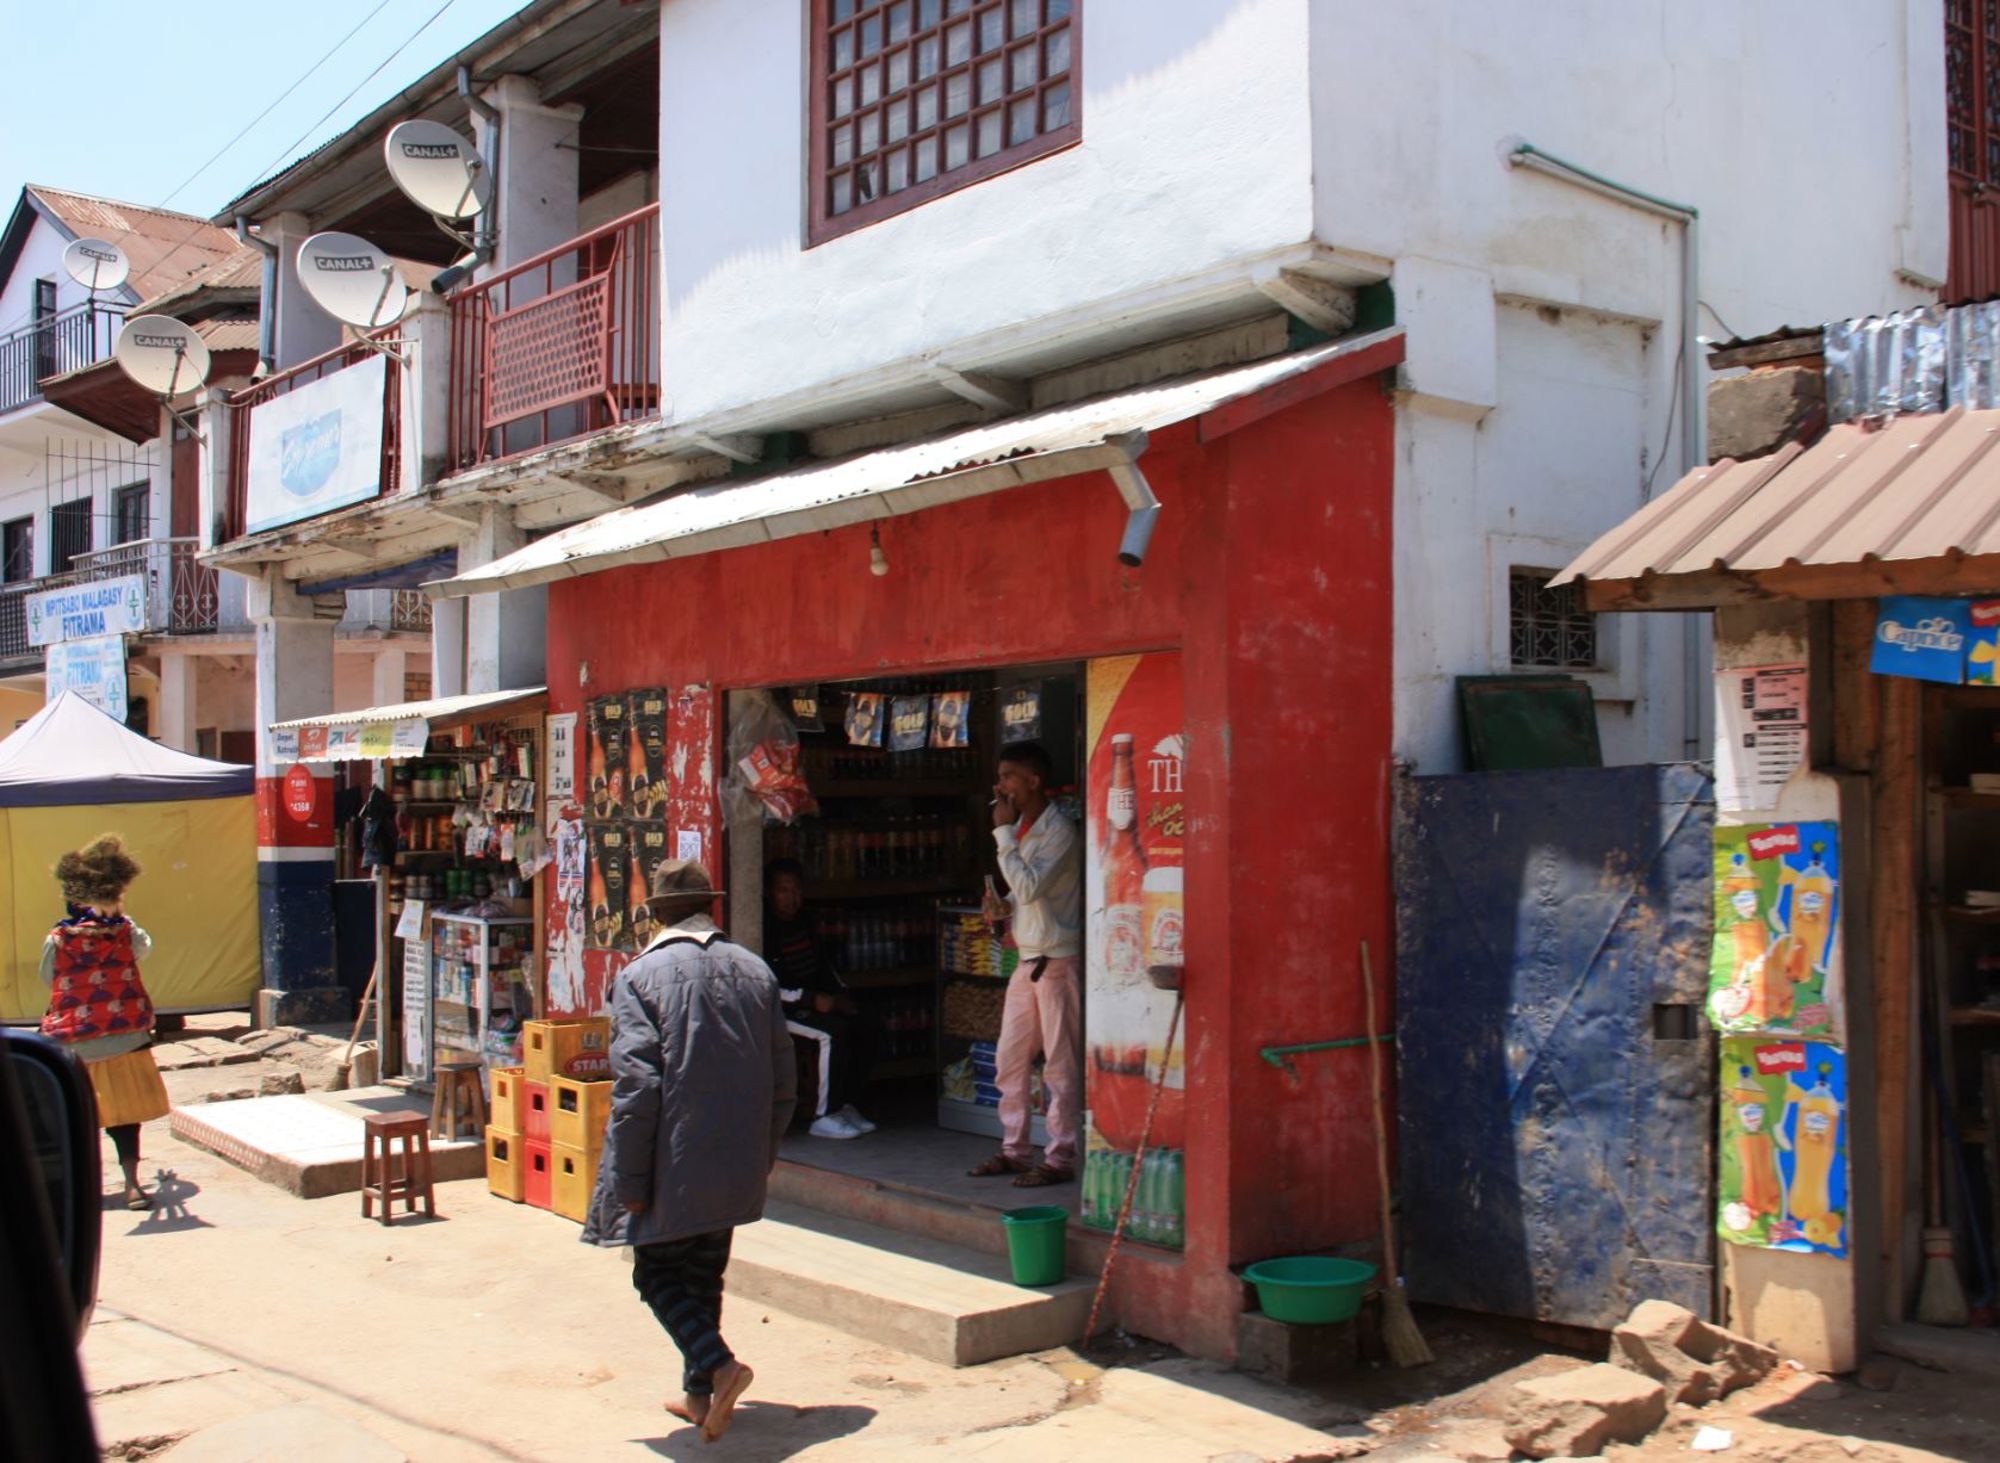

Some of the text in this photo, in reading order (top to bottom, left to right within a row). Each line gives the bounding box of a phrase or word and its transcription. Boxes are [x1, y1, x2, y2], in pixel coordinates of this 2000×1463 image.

[404, 144, 457, 158] CANAL+
[316, 257, 373, 270] CANAL+
[136, 335, 186, 348] CANAL+
[82, 587, 122, 610] MALAGASY
[63, 612, 105, 637] FITRAMA
[1005, 701, 1037, 720] GOLD
[894, 712, 925, 731] GOLD
[1147, 758, 1184, 793] TH
[573, 1058, 609, 1072] STAR
